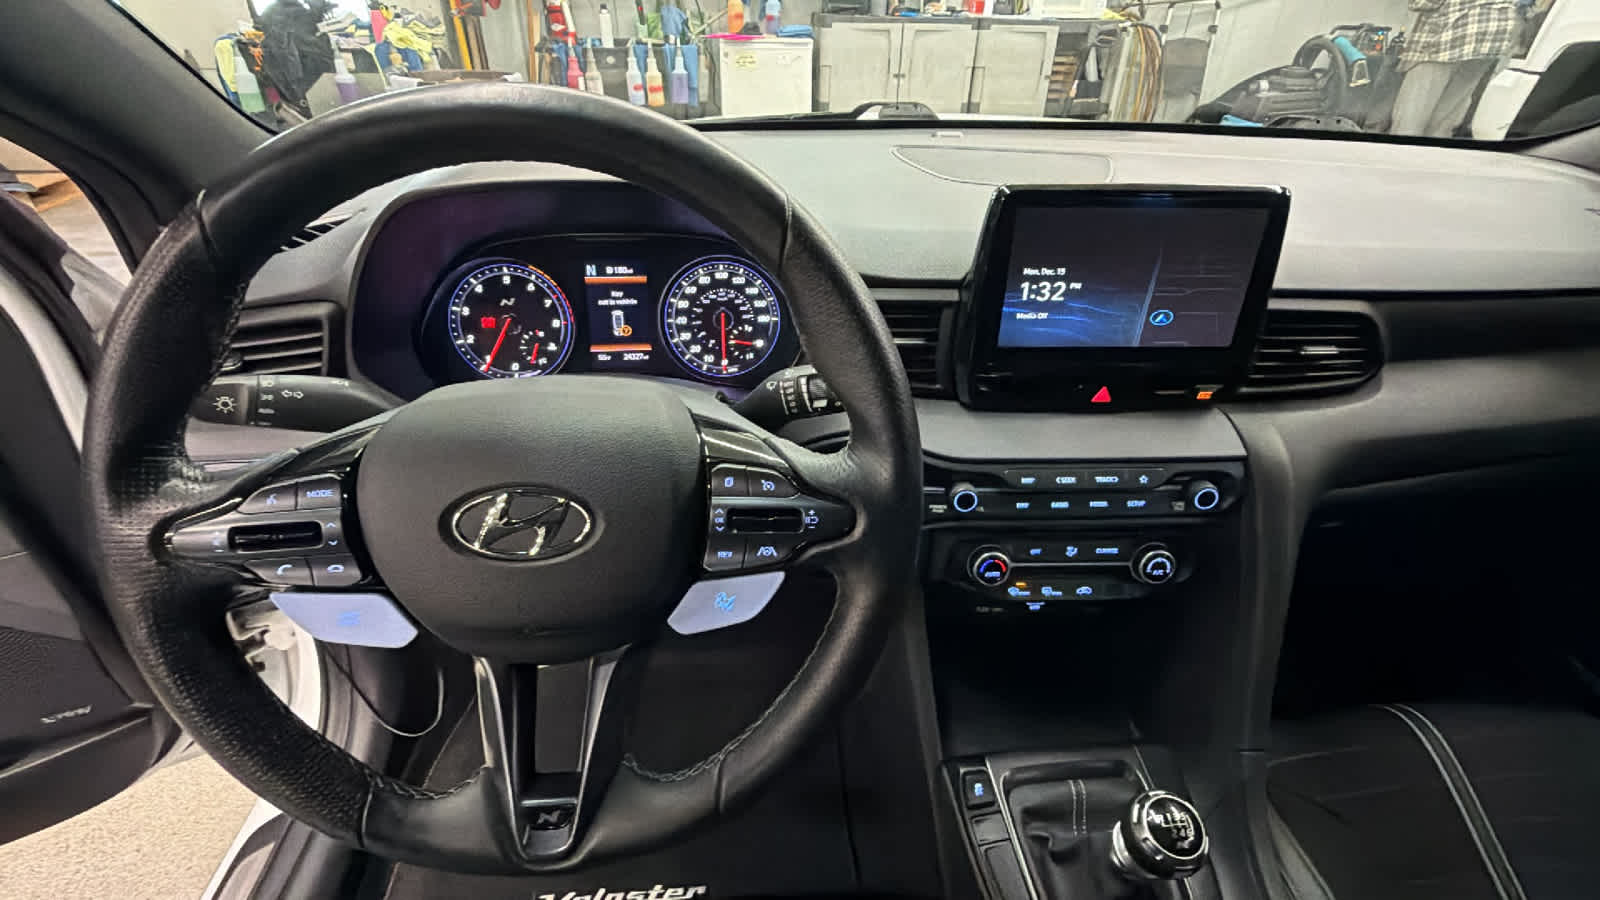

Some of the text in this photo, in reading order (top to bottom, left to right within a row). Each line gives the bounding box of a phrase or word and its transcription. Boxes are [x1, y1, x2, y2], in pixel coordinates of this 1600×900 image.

[586, 264, 597, 276] N
[502, 275, 511, 285] 5
[474, 283, 484, 294] 4
[526, 282, 536, 291] 6
[1020, 281, 1066, 301] 1:32
[544, 299, 553, 308] 7
[461, 306, 470, 316] 3
[551, 318, 561, 328] 8
[466, 334, 475, 344] 2
[511, 362, 520, 372] 0
[306, 489, 334, 498] MODE
